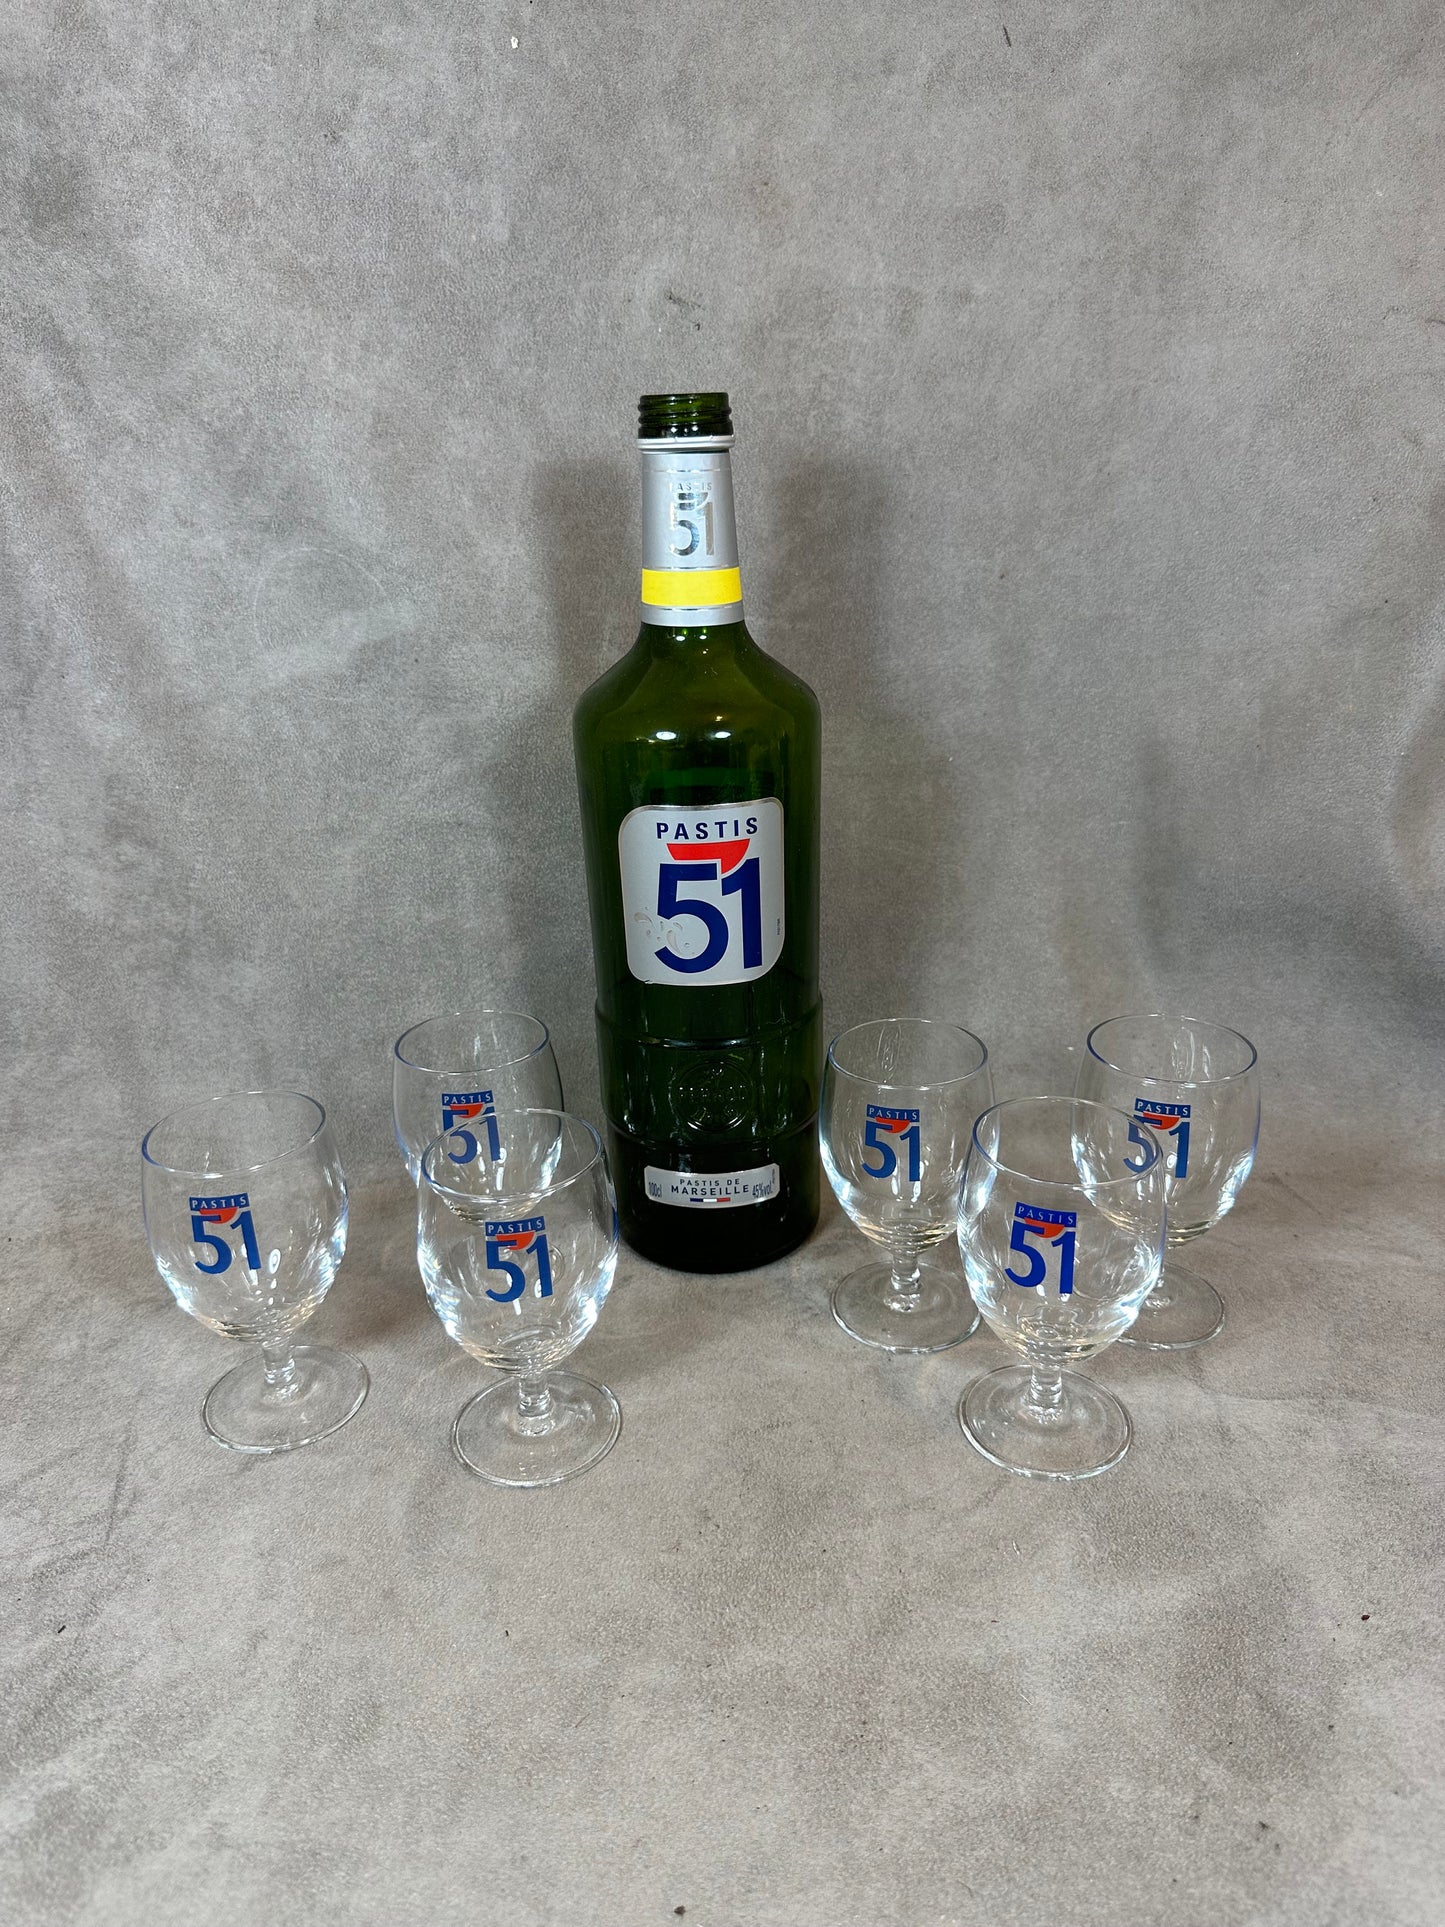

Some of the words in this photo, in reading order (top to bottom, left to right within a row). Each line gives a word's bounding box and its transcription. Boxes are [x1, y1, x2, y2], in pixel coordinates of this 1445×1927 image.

[669, 500, 715, 556] 51
[656, 817, 758, 839] PASTIS
[654, 857, 763, 974] 51
[443, 1093, 491, 1104] PASTIS
[1137, 1101, 1188, 1116] PASTIS
[868, 1107, 918, 1120] PASTIS
[442, 1106, 501, 1165] 51
[1123, 1114, 1190, 1178] 51
[862, 1120, 920, 1182] 51
[671, 1184, 749, 1196] MARSEILLE
[680, 1178, 720, 1187] PASTIS
[727, 1178, 740, 1186] DE
[192, 1196, 247, 1208] PASTIS
[488, 1219, 542, 1234] PASTIS
[1018, 1206, 1074, 1225] PASTIS
[191, 1210, 261, 1274] 51
[1004, 1220, 1076, 1294] 51
[485, 1234, 553, 1303] 51
